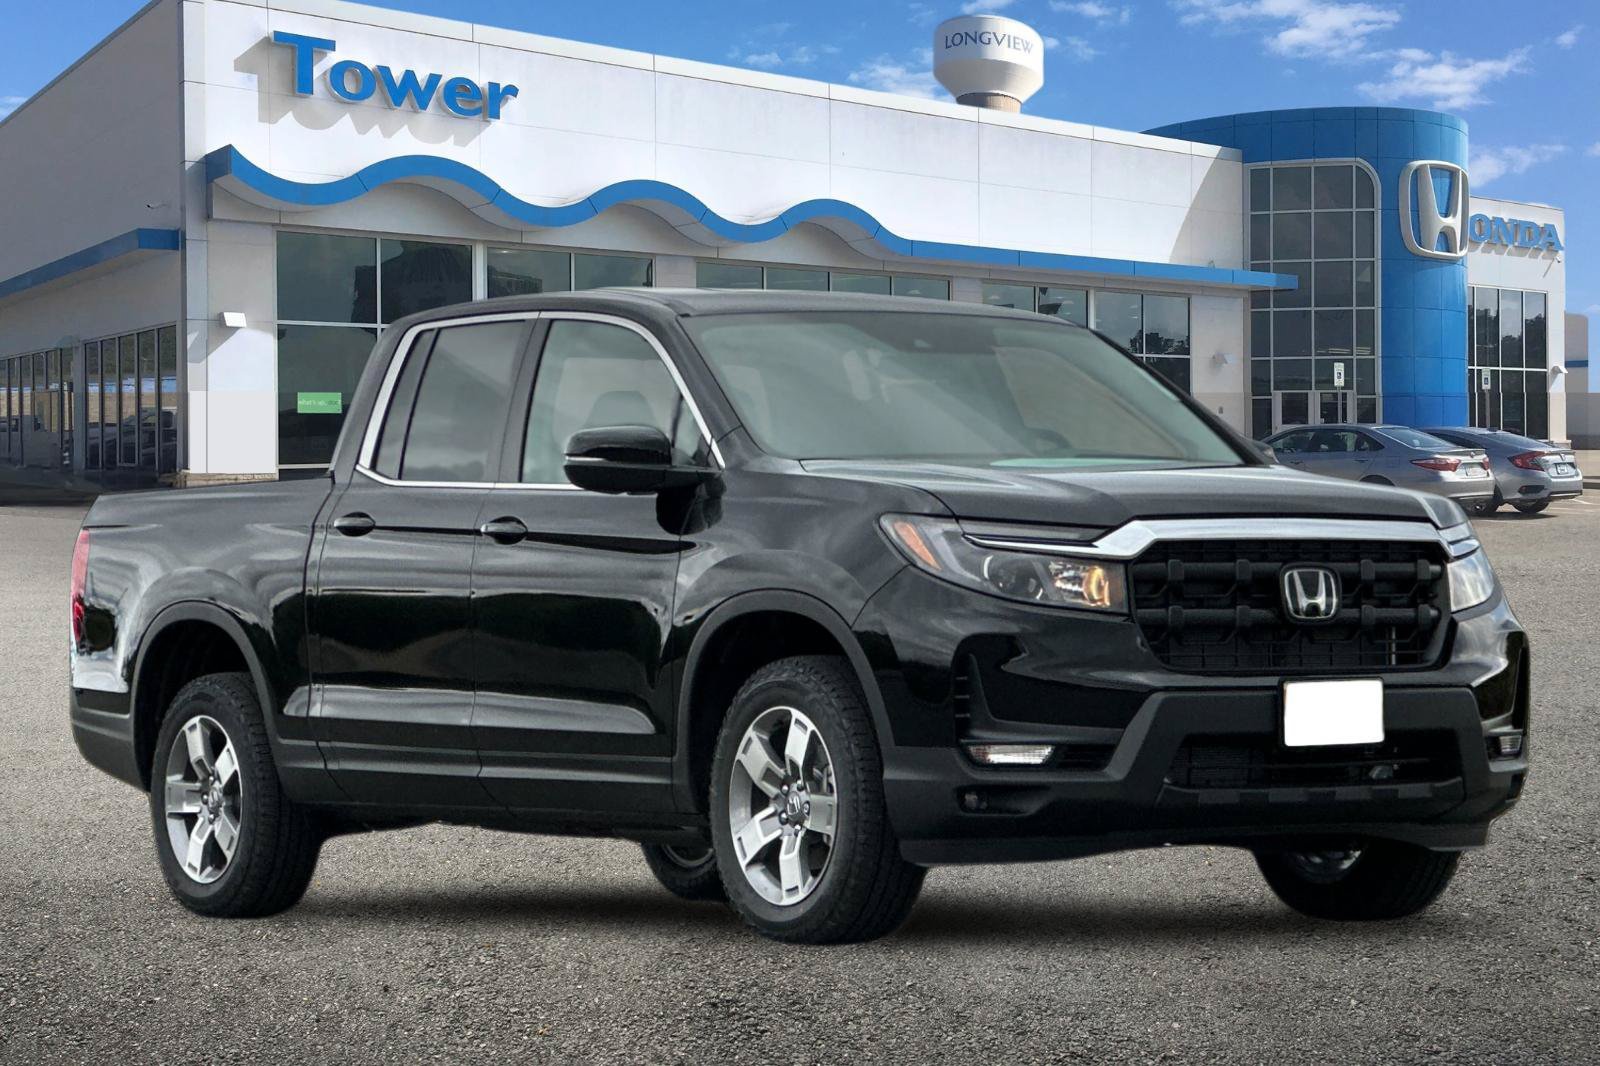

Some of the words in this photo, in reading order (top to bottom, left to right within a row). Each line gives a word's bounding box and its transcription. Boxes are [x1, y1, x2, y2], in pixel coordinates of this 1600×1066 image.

[945, 31, 1034, 54] LONGVIEW
[273, 30, 519, 120] Tower
[1469, 213, 1564, 251] ONDA
